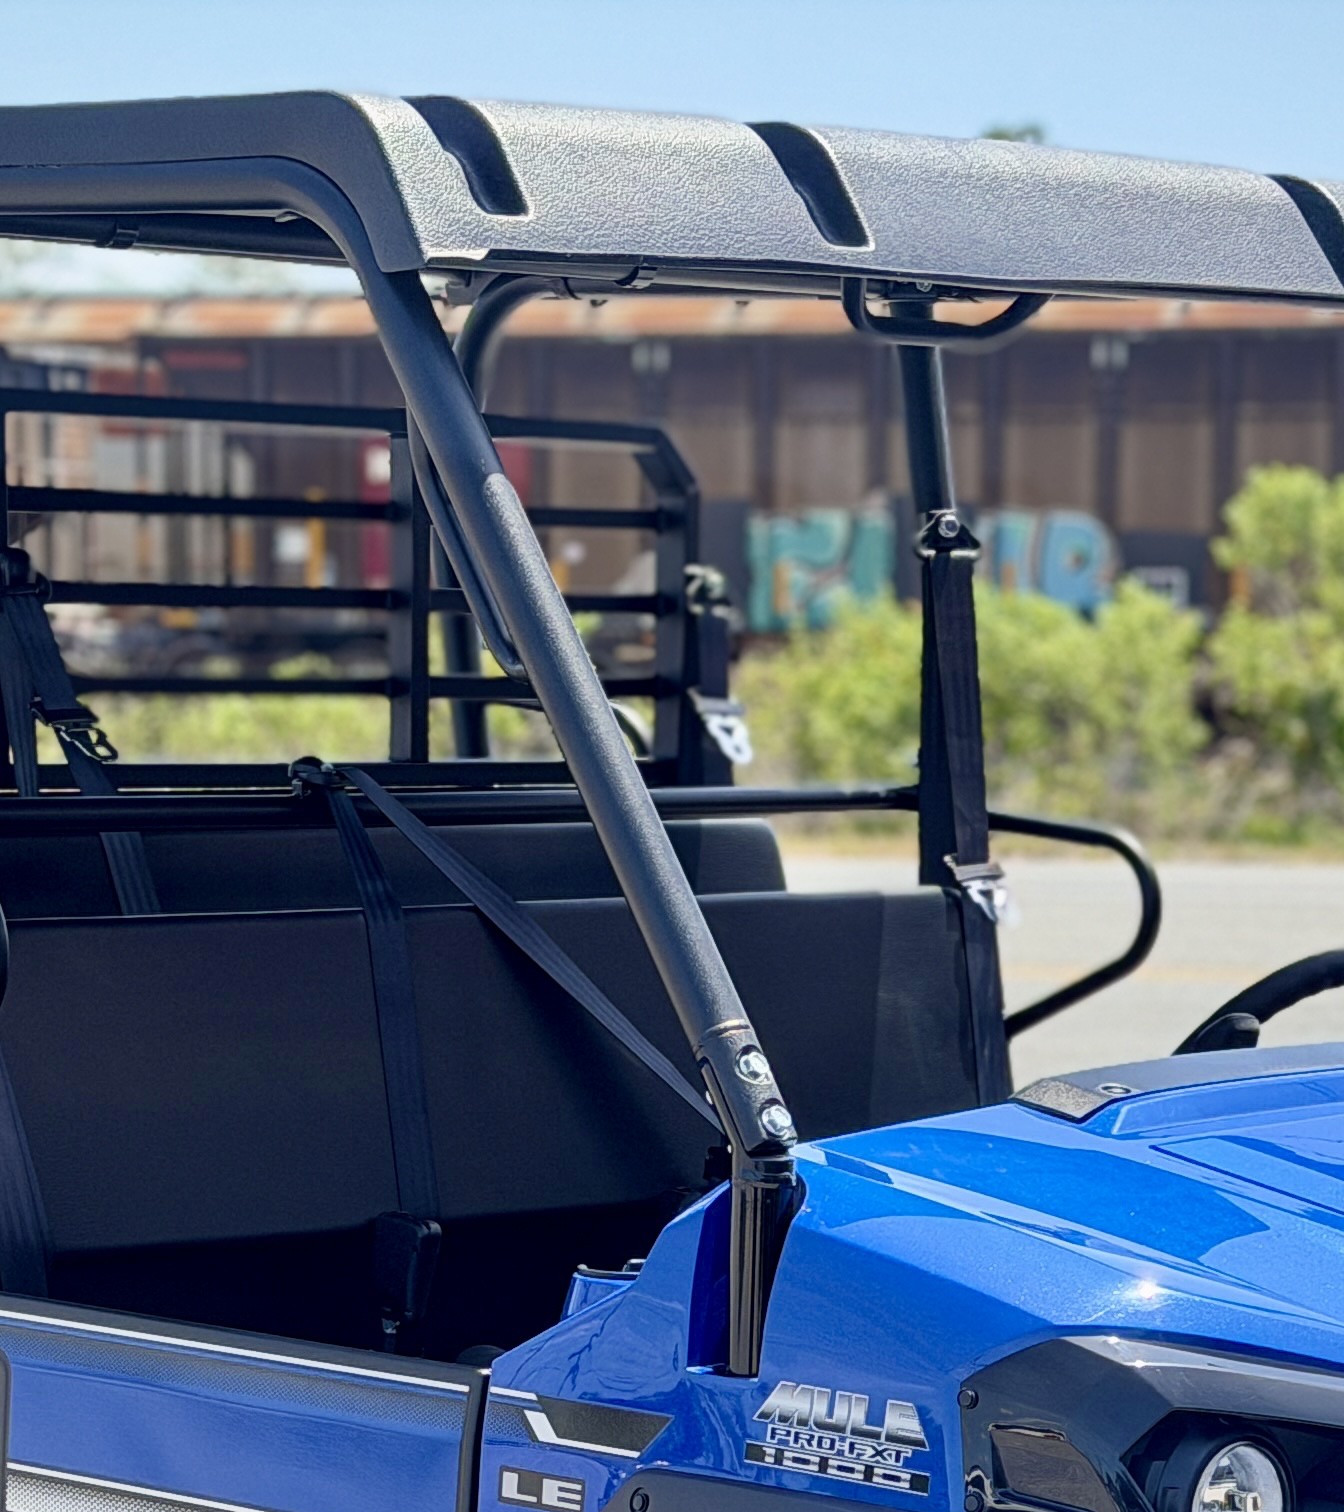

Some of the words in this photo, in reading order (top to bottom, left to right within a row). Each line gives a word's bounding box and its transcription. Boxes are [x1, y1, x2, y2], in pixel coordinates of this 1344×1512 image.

[753, 1380, 930, 1451] MULE
[766, 1423, 913, 1467] PRO-FXT
[762, 1446, 911, 1489] 1000
[500, 1468, 583, 1512] LE
